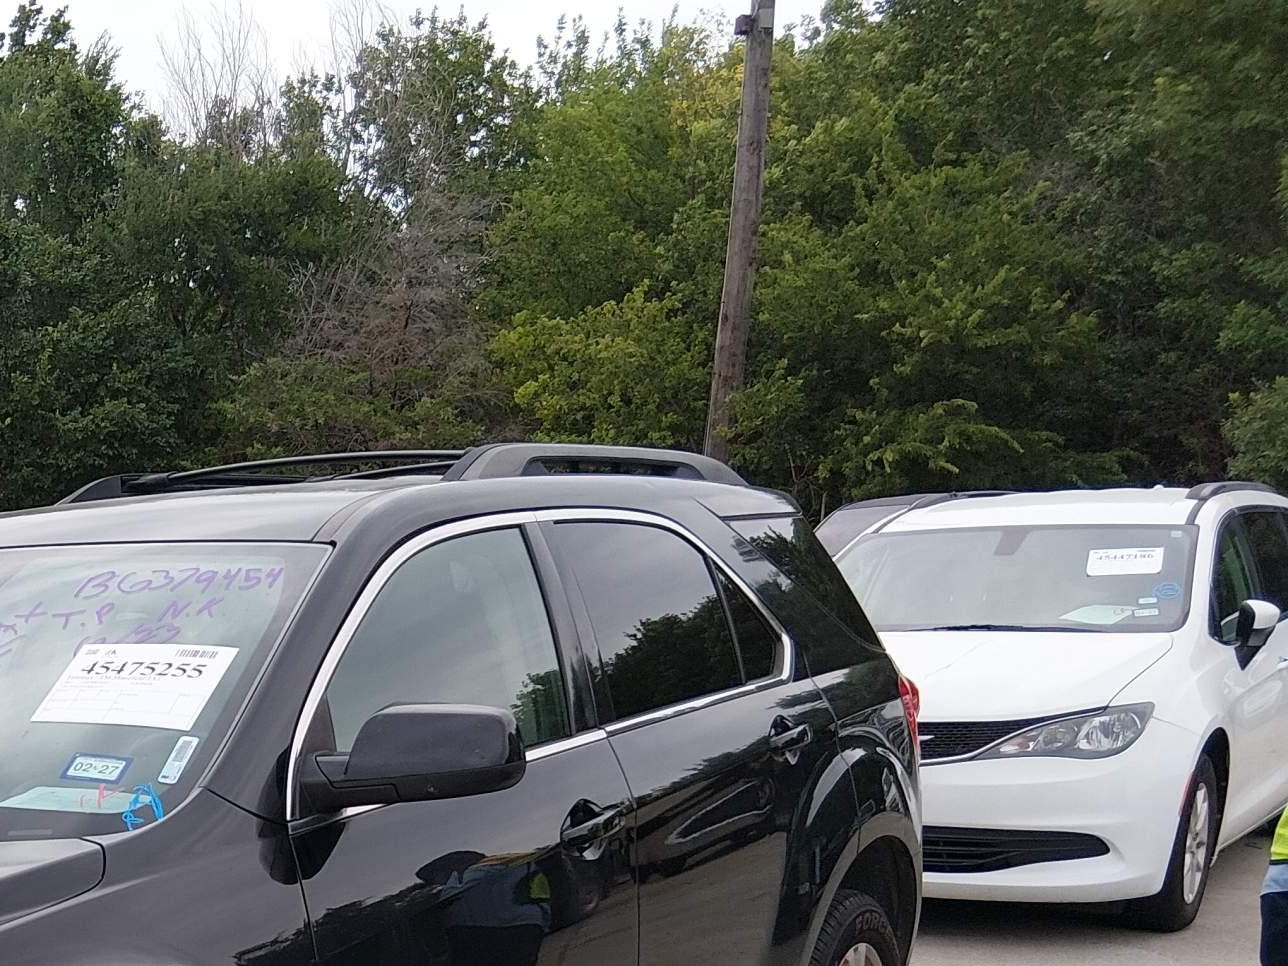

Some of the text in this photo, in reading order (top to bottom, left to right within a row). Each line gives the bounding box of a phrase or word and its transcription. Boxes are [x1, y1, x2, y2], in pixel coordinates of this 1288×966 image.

[81, 660, 208, 679] 45475255
[73, 761, 120, 776] 02 27
